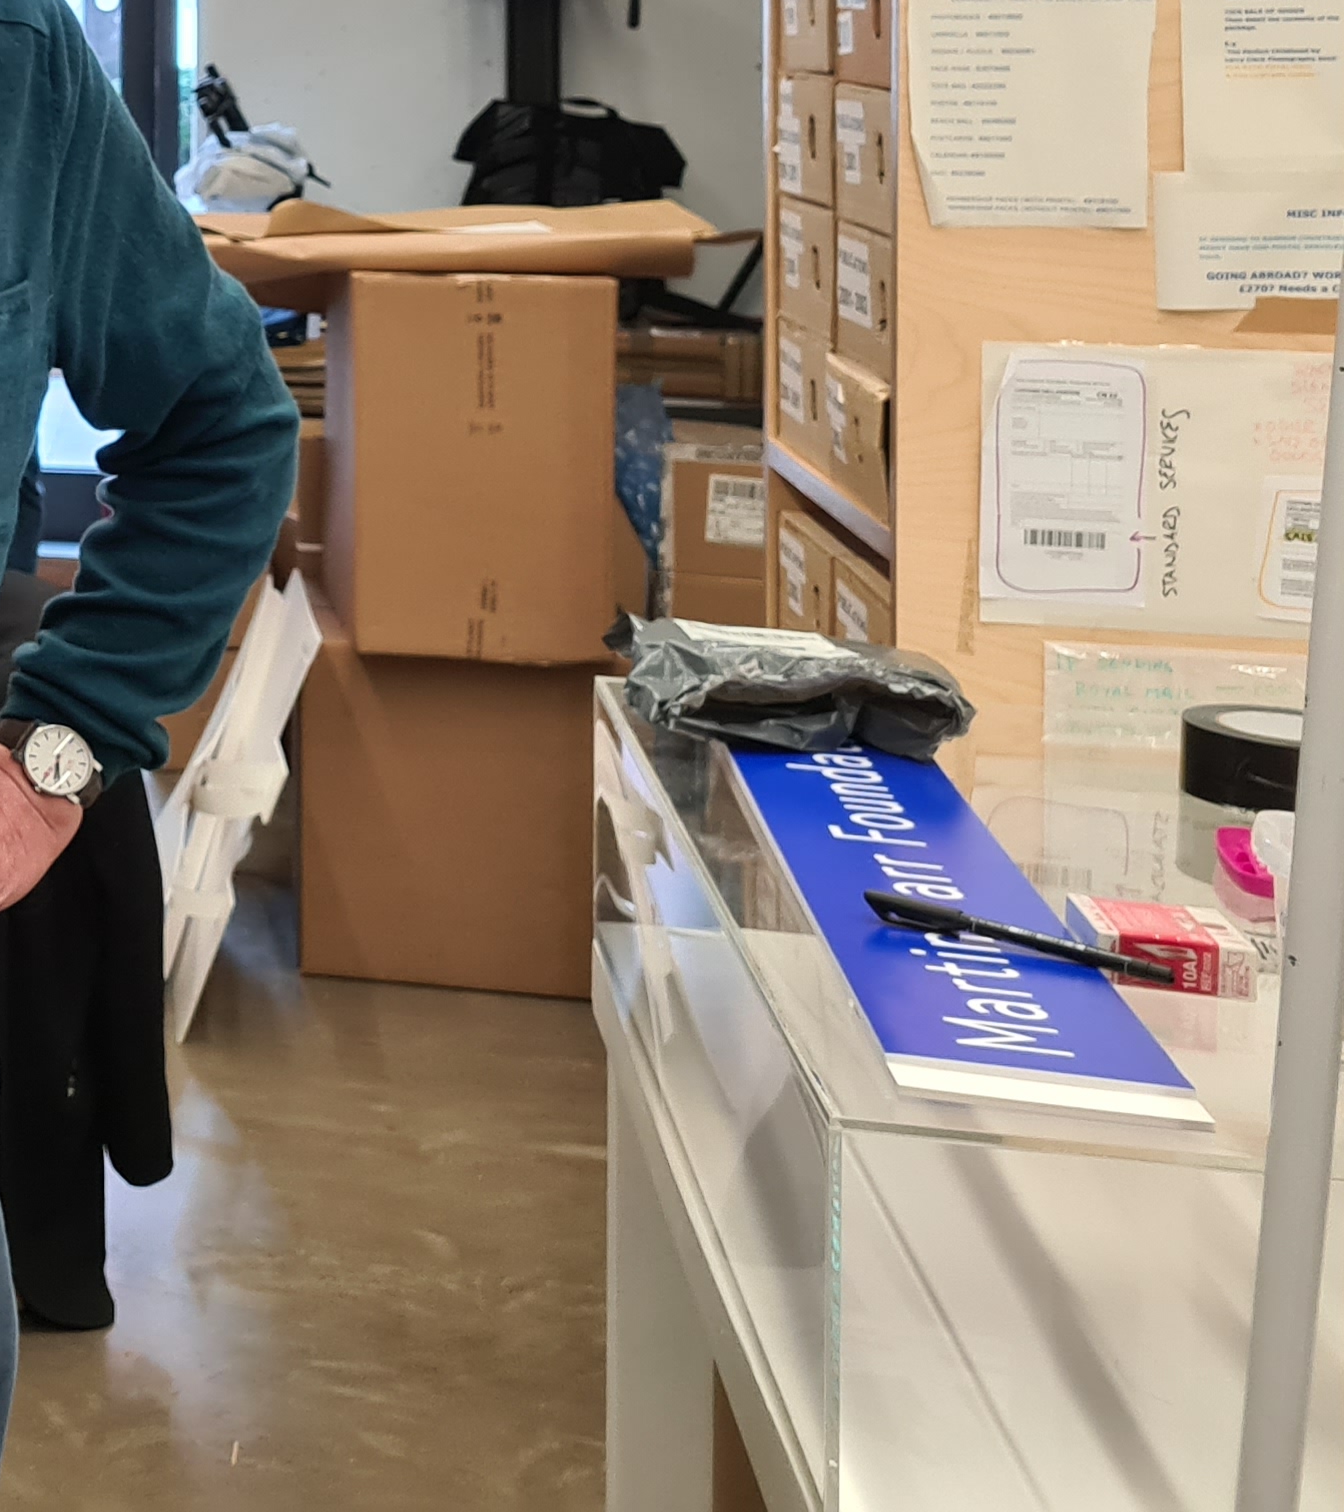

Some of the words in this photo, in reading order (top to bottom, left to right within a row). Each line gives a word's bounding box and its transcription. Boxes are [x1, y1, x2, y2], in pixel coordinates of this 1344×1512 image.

[1287, 210, 1317, 218] MISC
[1206, 272, 1247, 281] GOING
[1250, 272, 1308, 280] ABROAD?
[1278, 284, 1317, 292] Needs
[1162, 506, 1181, 598] STANDARD
[786, 745, 927, 847] Founda
[873, 853, 964, 901] arr
[1182, 961, 1198, 989] 10A
